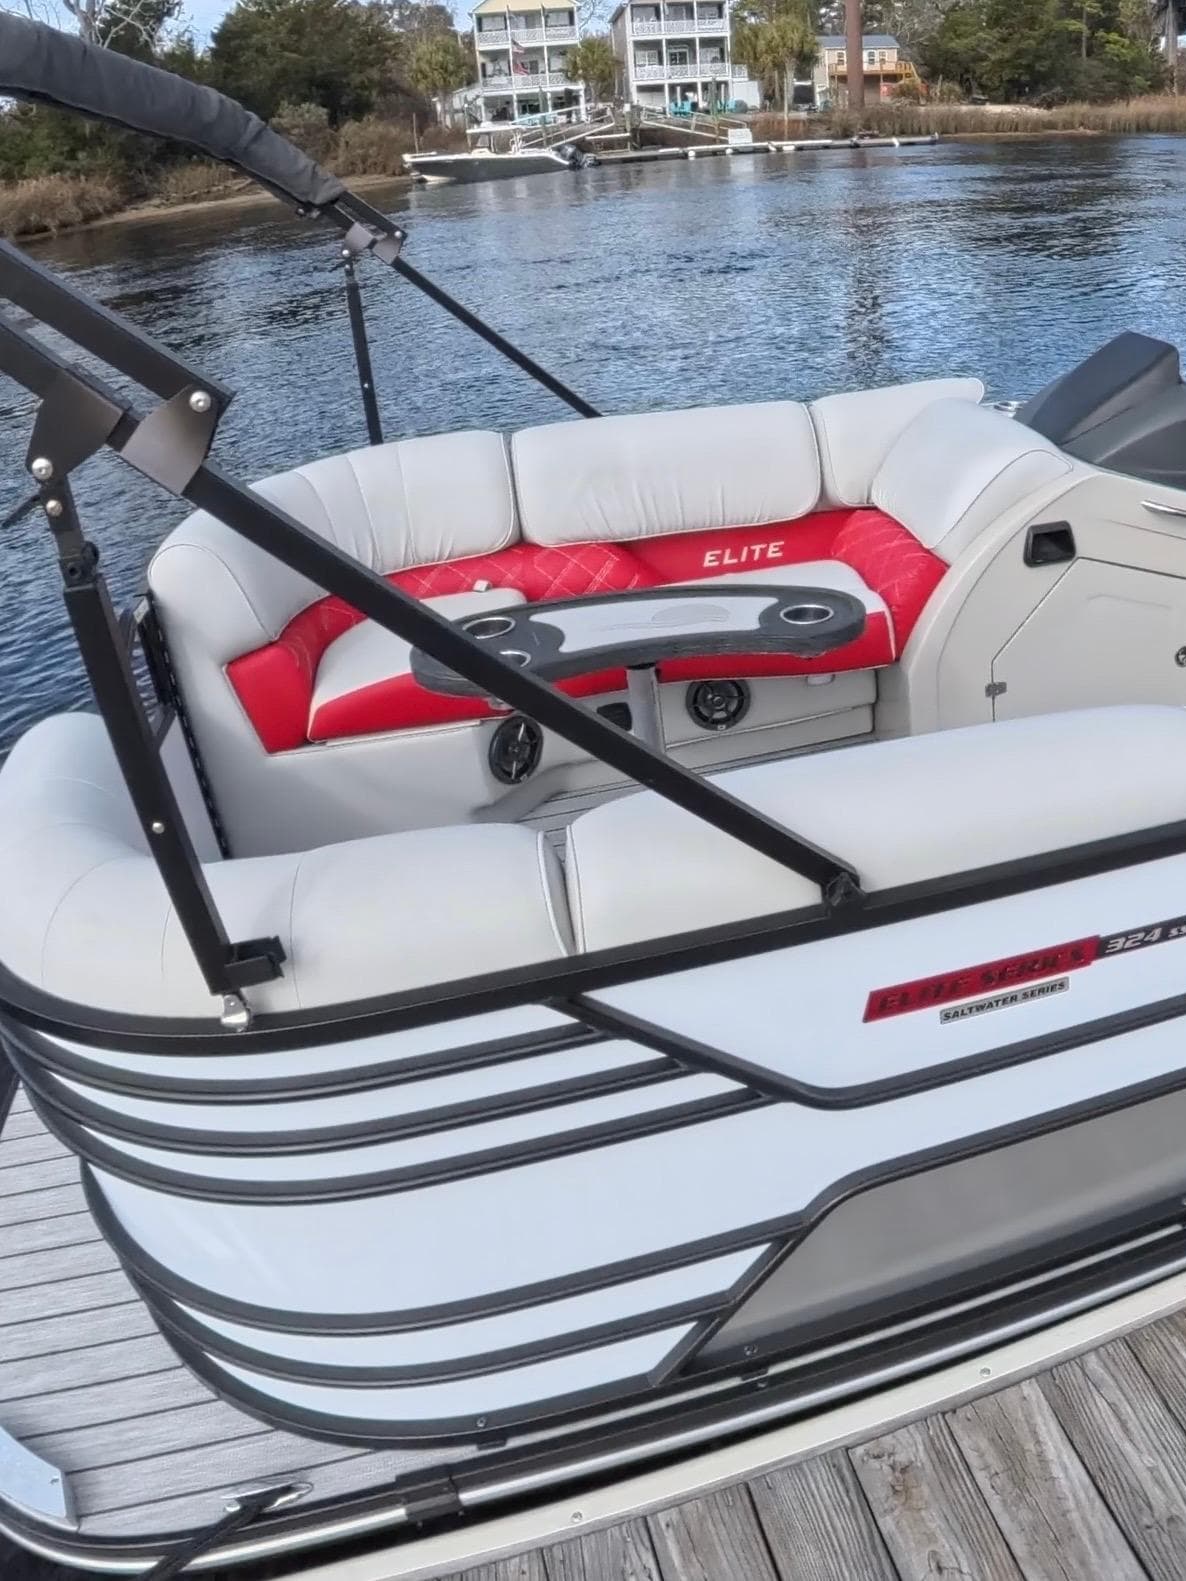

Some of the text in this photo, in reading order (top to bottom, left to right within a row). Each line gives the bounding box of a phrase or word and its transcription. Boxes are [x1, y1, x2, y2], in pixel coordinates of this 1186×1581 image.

[703, 541, 785, 567] ELITE
[1104, 927, 1162, 953] 324
[943, 981, 1065, 1021] SALTWATER SERIES
